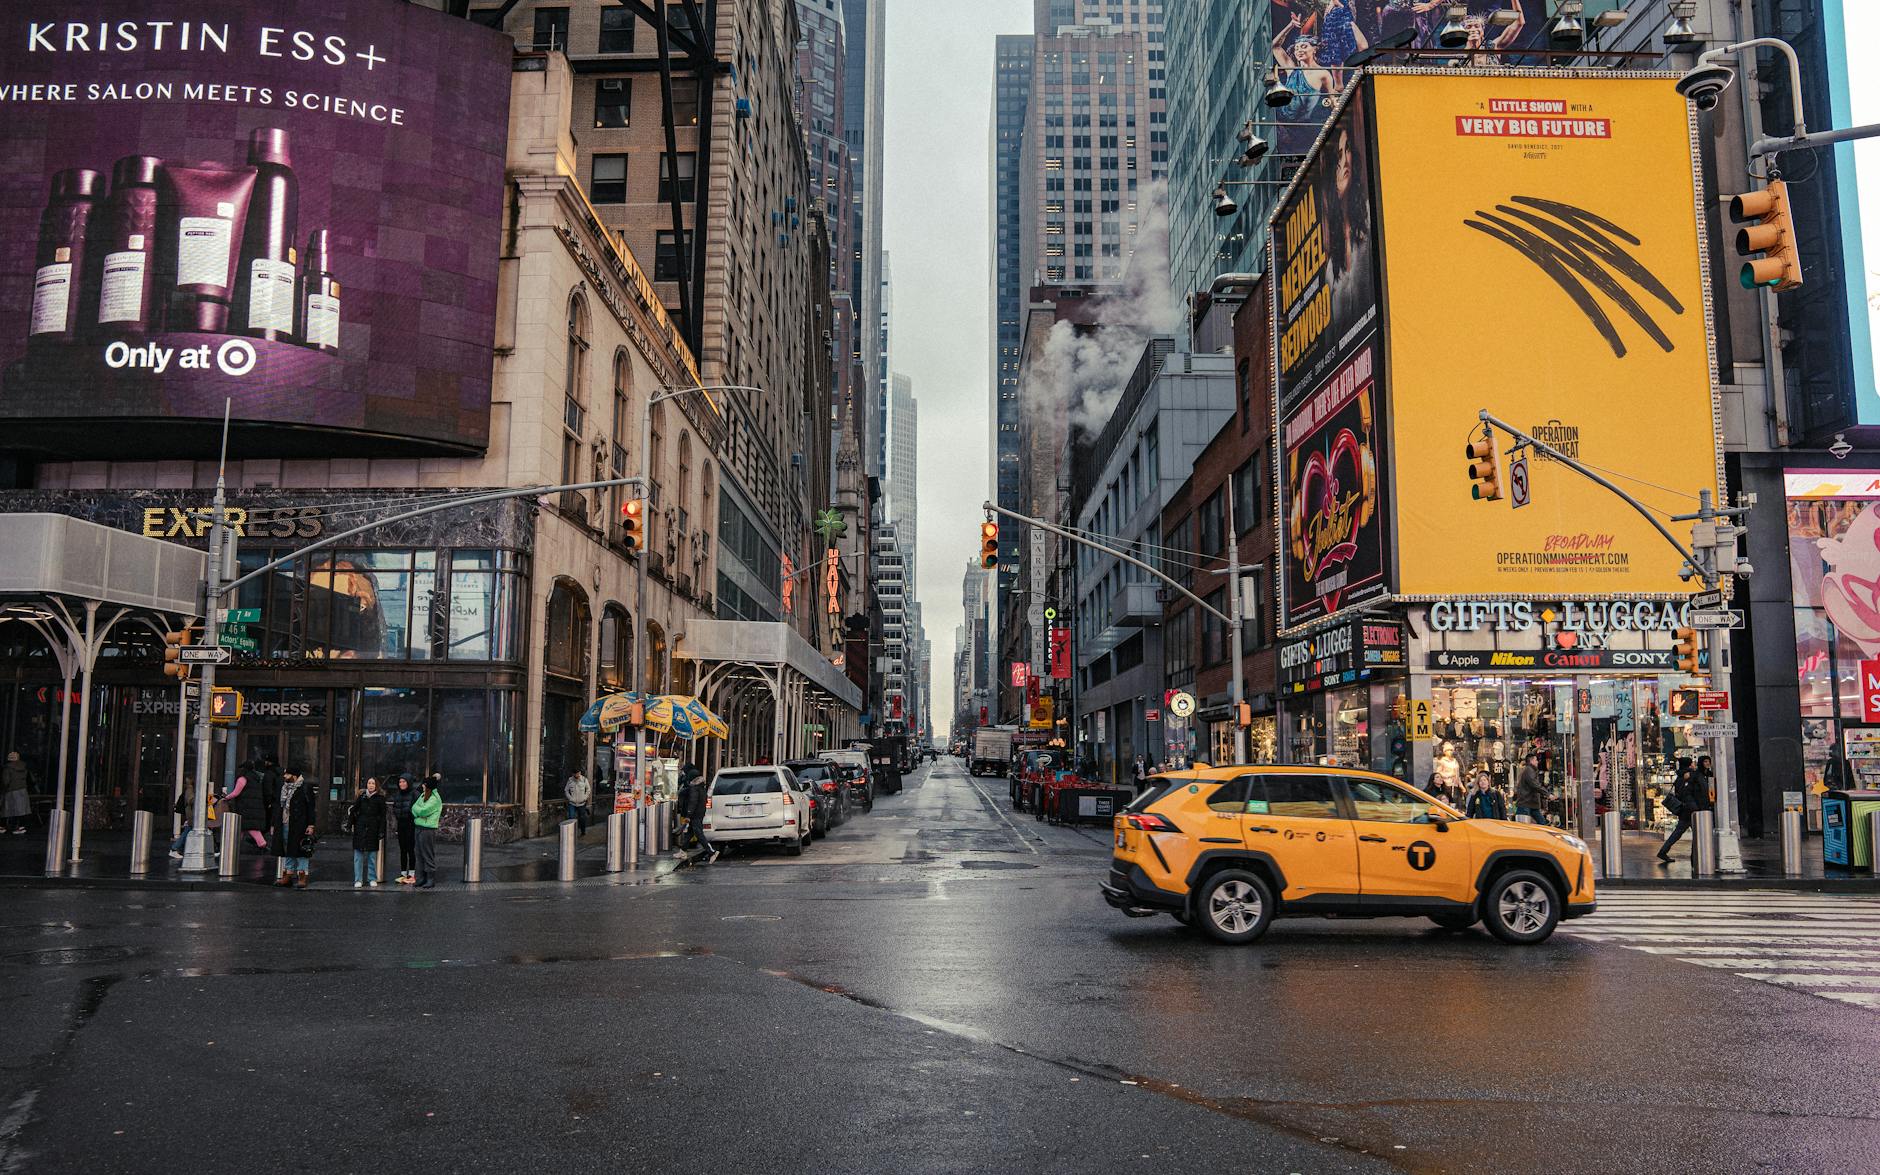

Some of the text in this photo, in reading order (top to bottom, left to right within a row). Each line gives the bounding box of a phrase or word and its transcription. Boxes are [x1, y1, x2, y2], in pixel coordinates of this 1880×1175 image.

[29, 21, 229, 53] KRISTIN
[87, 83, 173, 100] SALON
[184, 84, 273, 105] MEETS
[285, 91, 405, 126] SCIENCE
[1491, 100, 1528, 113] LITTLE
[1529, 101, 1564, 113] SHOW
[1570, 104, 1588, 112] WITH
[1588, 104, 1593, 112] A
[1461, 118, 1506, 134] VERY
[1508, 119, 1539, 135] BIG
[1286, 184, 1317, 262] IDINA
[1281, 222, 1326, 315] MENZEL
[1281, 283, 1331, 375] REDWOOD
[105, 341, 211, 373] Only at
[1531, 425, 1579, 442] OPERATION
[142, 507, 323, 538] EXPRESS
[1544, 533, 1616, 552] BROADWAY
[1496, 552, 1629, 565] OPERATIONMINCEMEAT.COM
[828, 548, 844, 646] HAVANA
[1693, 593, 1718, 606] ONE WAY
[236, 611, 242, 621] 7
[1430, 601, 1533, 631] GIFTS
[1699, 615, 1736, 624] ONE WAY
[228, 624, 238, 634] 46
[1363, 625, 1400, 646] ELECTRONICS
[220, 634, 255, 649] Actors' Equity
[1577, 632, 1614, 650] NY
[1281, 640, 1308, 669] GIFTS
[1451, 652, 1671, 667] Apple Nikon Canon SONY
[1324, 673, 1341, 687] SONY
[1515, 694, 1544, 706] 1650
[1581, 689, 1589, 712] ATM
[243, 703, 311, 716] EXPRESS
[1417, 702, 1429, 735] ATM
